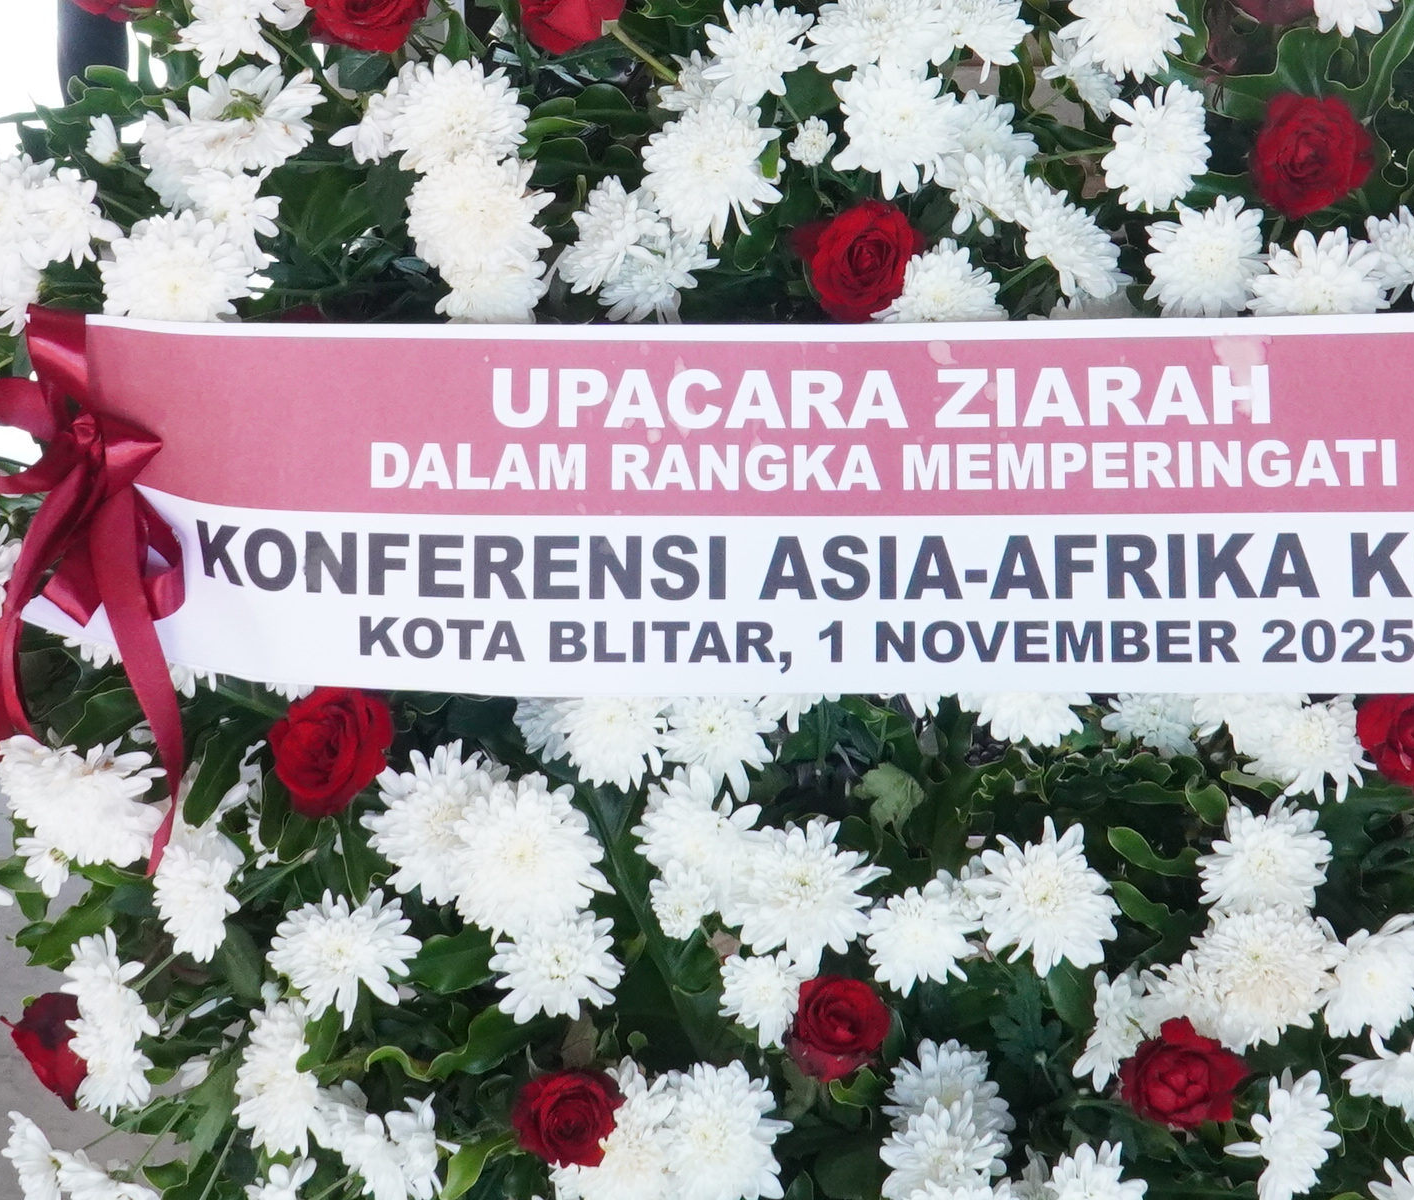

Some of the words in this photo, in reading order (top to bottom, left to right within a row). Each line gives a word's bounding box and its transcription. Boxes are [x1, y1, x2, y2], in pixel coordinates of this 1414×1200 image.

[492, 367, 909, 430] UPACARA
[934, 364, 1272, 428] ZIARAH
[370, 441, 587, 491] DALAM
[611, 443, 882, 492] RANGKA
[902, 438, 1398, 491] MEMPERINGATI
[195, 519, 727, 601] KONFERENSI
[759, 533, 1321, 601] ASIA-AFRIKA
[359, 616, 525, 663] KOTA
[549, 621, 793, 674] BLITAR,
[818, 620, 844, 663] 1
[875, 620, 1241, 664] NOVEMBER
